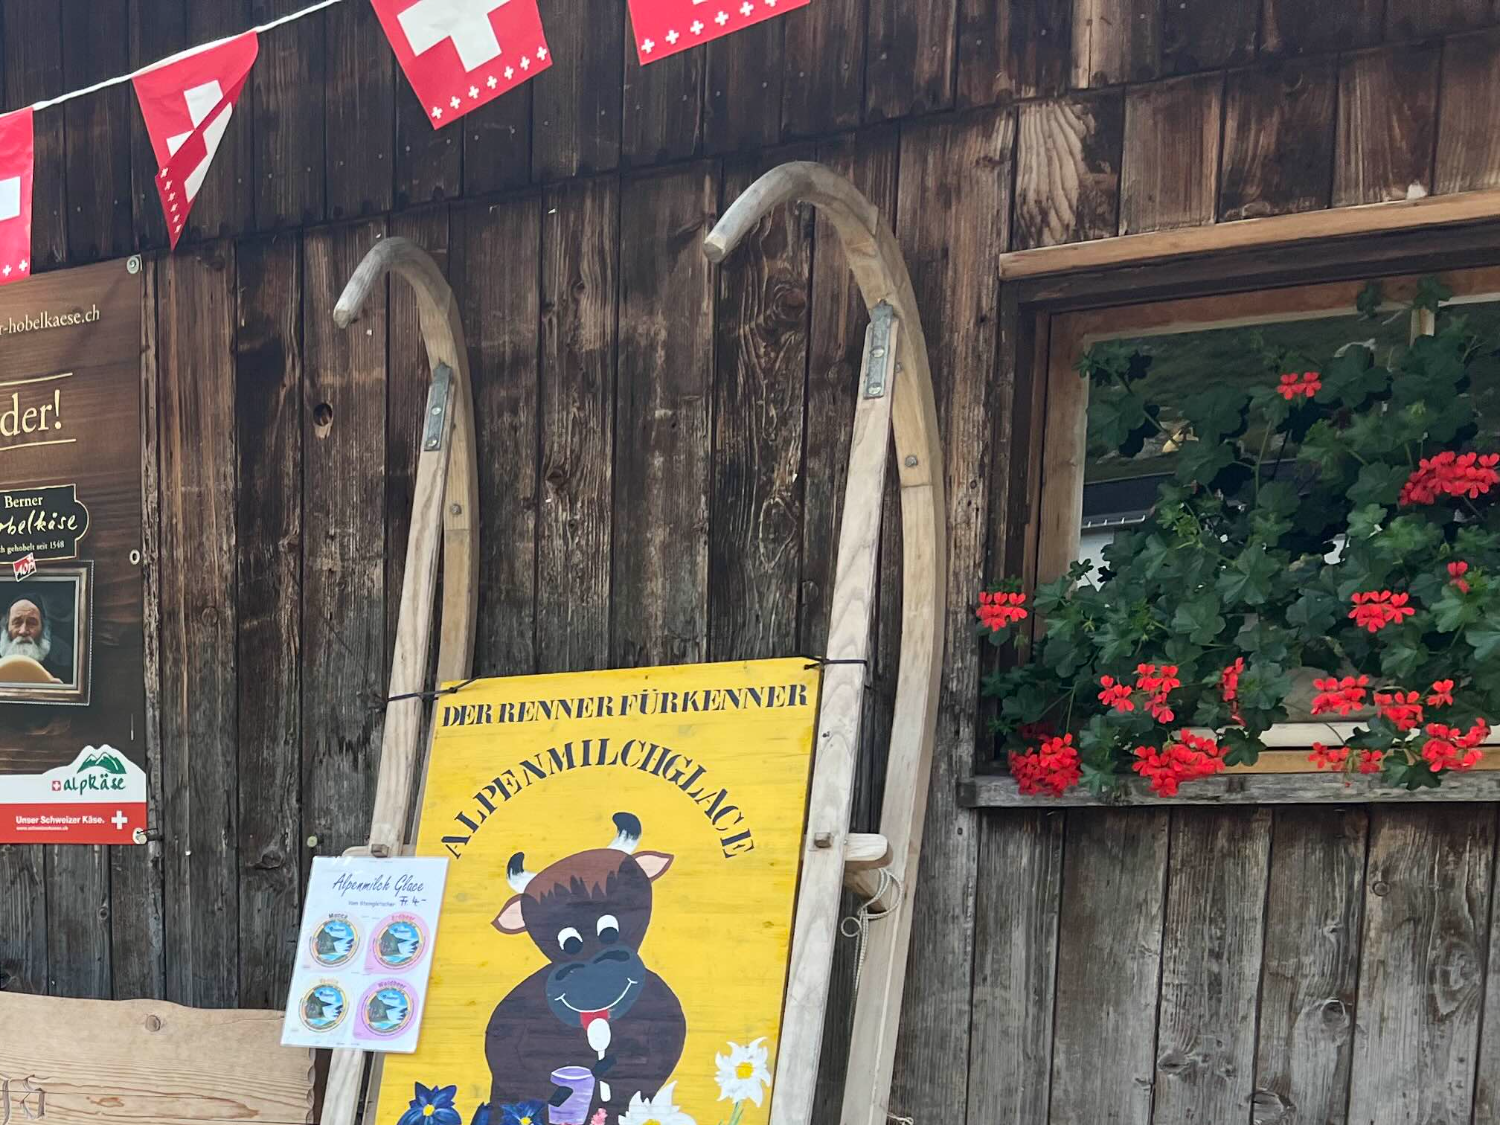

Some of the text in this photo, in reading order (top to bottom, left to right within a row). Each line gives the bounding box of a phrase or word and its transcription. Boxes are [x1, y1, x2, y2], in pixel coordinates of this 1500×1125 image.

[4, 495, 43, 508] Berner
[442, 703, 492, 727] DER
[498, 695, 614, 724] RENNER
[440, 737, 755, 859] ALPENMILCHGLACE
[332, 873, 424, 897] Alpenmilch Glace
